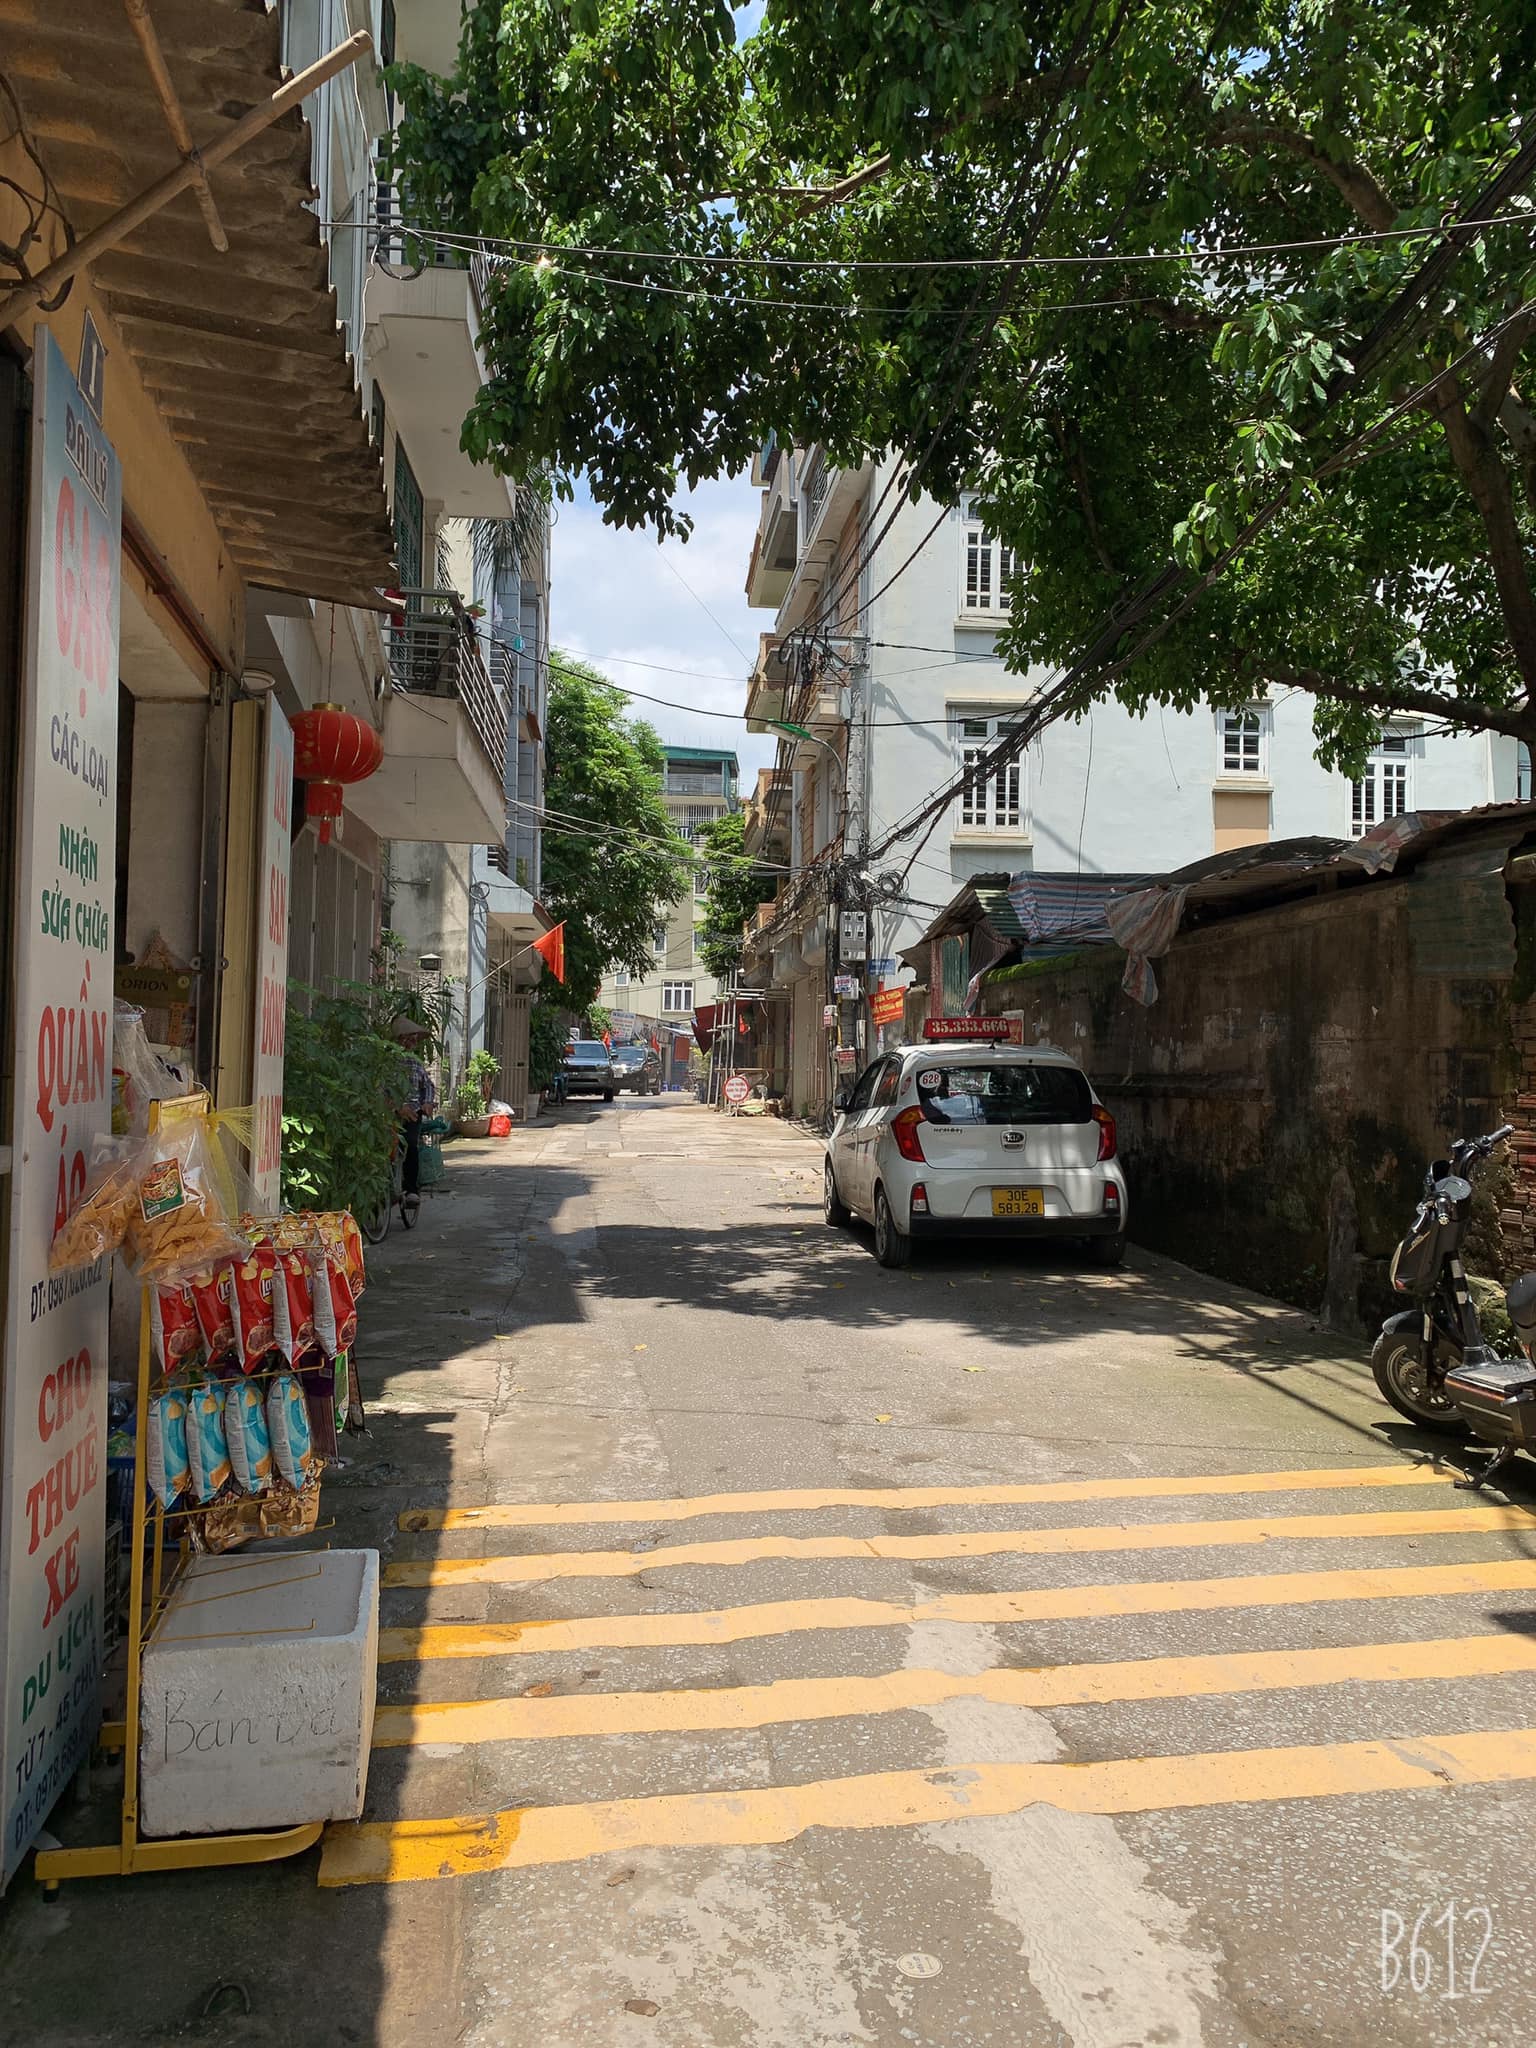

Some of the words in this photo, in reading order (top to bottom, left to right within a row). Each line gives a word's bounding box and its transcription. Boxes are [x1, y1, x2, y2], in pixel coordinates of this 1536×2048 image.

[51, 712, 79, 775] CÁC
[82, 739, 108, 807] LOẠI
[59, 823, 98, 887] NHẬN
[41, 879, 71, 943] SỬA
[75, 900, 108, 954] CHỮA
[121, 979, 169, 991] ORION
[36, 959, 108, 1133] QUẦN
[931, 1020, 1008, 1033] 35.333.666
[922, 1074, 940, 1085] 628
[998, 1202, 1039, 1214] 583.28
[1007, 1190, 1028, 1202] 30E
[38, 1347, 92, 1442] CHO
[26, 1410, 98, 1555] THUÊ
[42, 1527, 80, 1630] XE
[22, 1650, 51, 1726] DU
[58, 1594, 95, 1673] LỊCH
[38, 1725, 46, 1763] 7
[56, 1693, 70, 1733] 45
